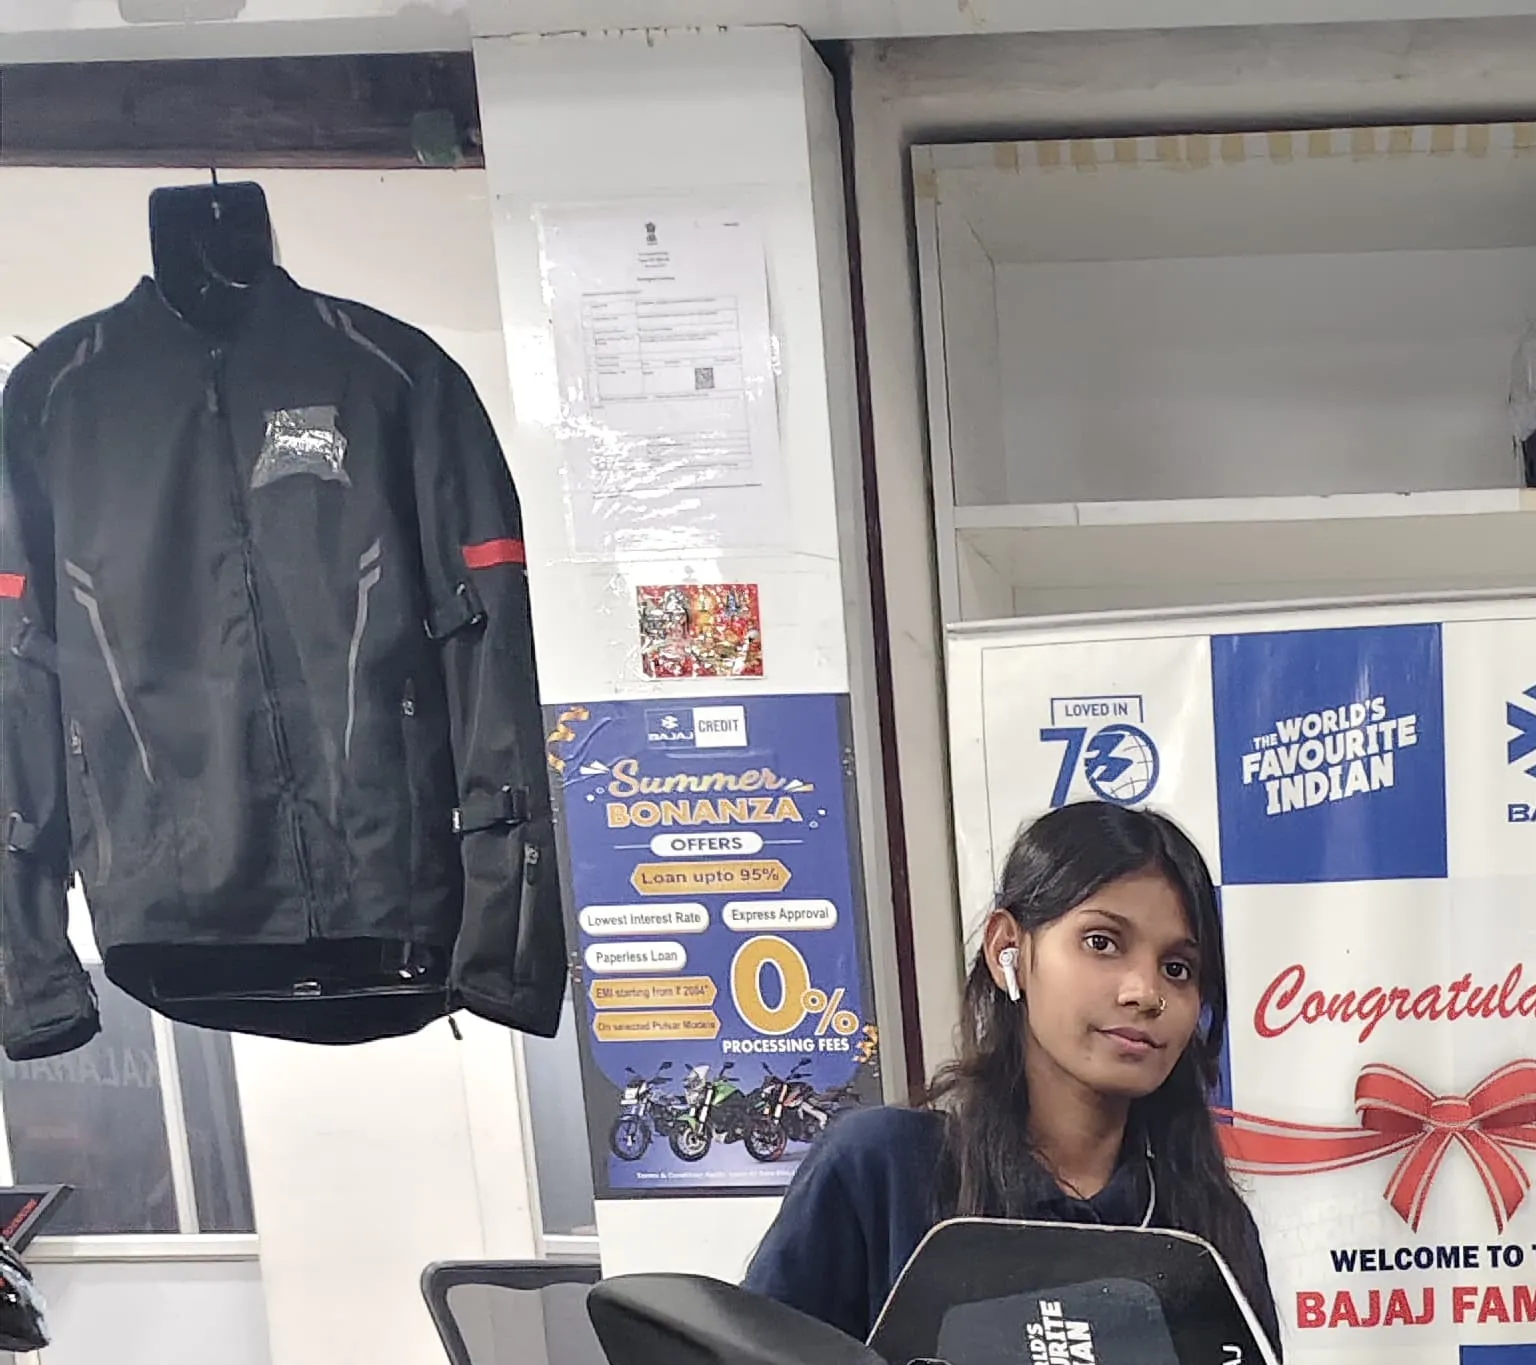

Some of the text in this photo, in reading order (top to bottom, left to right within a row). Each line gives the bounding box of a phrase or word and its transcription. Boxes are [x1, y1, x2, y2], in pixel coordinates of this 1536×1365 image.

[1064, 702, 1128, 717] LOVED IN
[698, 719, 739, 733] CREDIT
[1253, 696, 1387, 750] THE WORLD'S
[648, 731, 694, 741] BAJAJ
[1241, 714, 1417, 785] FAVOURITE
[608, 759, 786, 797] Summer
[1265, 751, 1394, 816] INDIAN
[607, 797, 803, 828] BONANZA
[670, 837, 743, 851] OFFERS
[641, 868, 779, 885] Loan upto 95%
[587, 911, 701, 927] Lowest Interest Rate
[731, 907, 829, 923] Express Approval
[596, 950, 678, 966] Paperless Loan
[730, 934, 859, 1036] 0%
[722, 1038, 850, 1053] PROCESSING FEES
[1330, 1245, 1479, 1273] WELCOME
[1486, 1244, 1525, 1268] TO
[1295, 1287, 1435, 1329] BAJAJ
